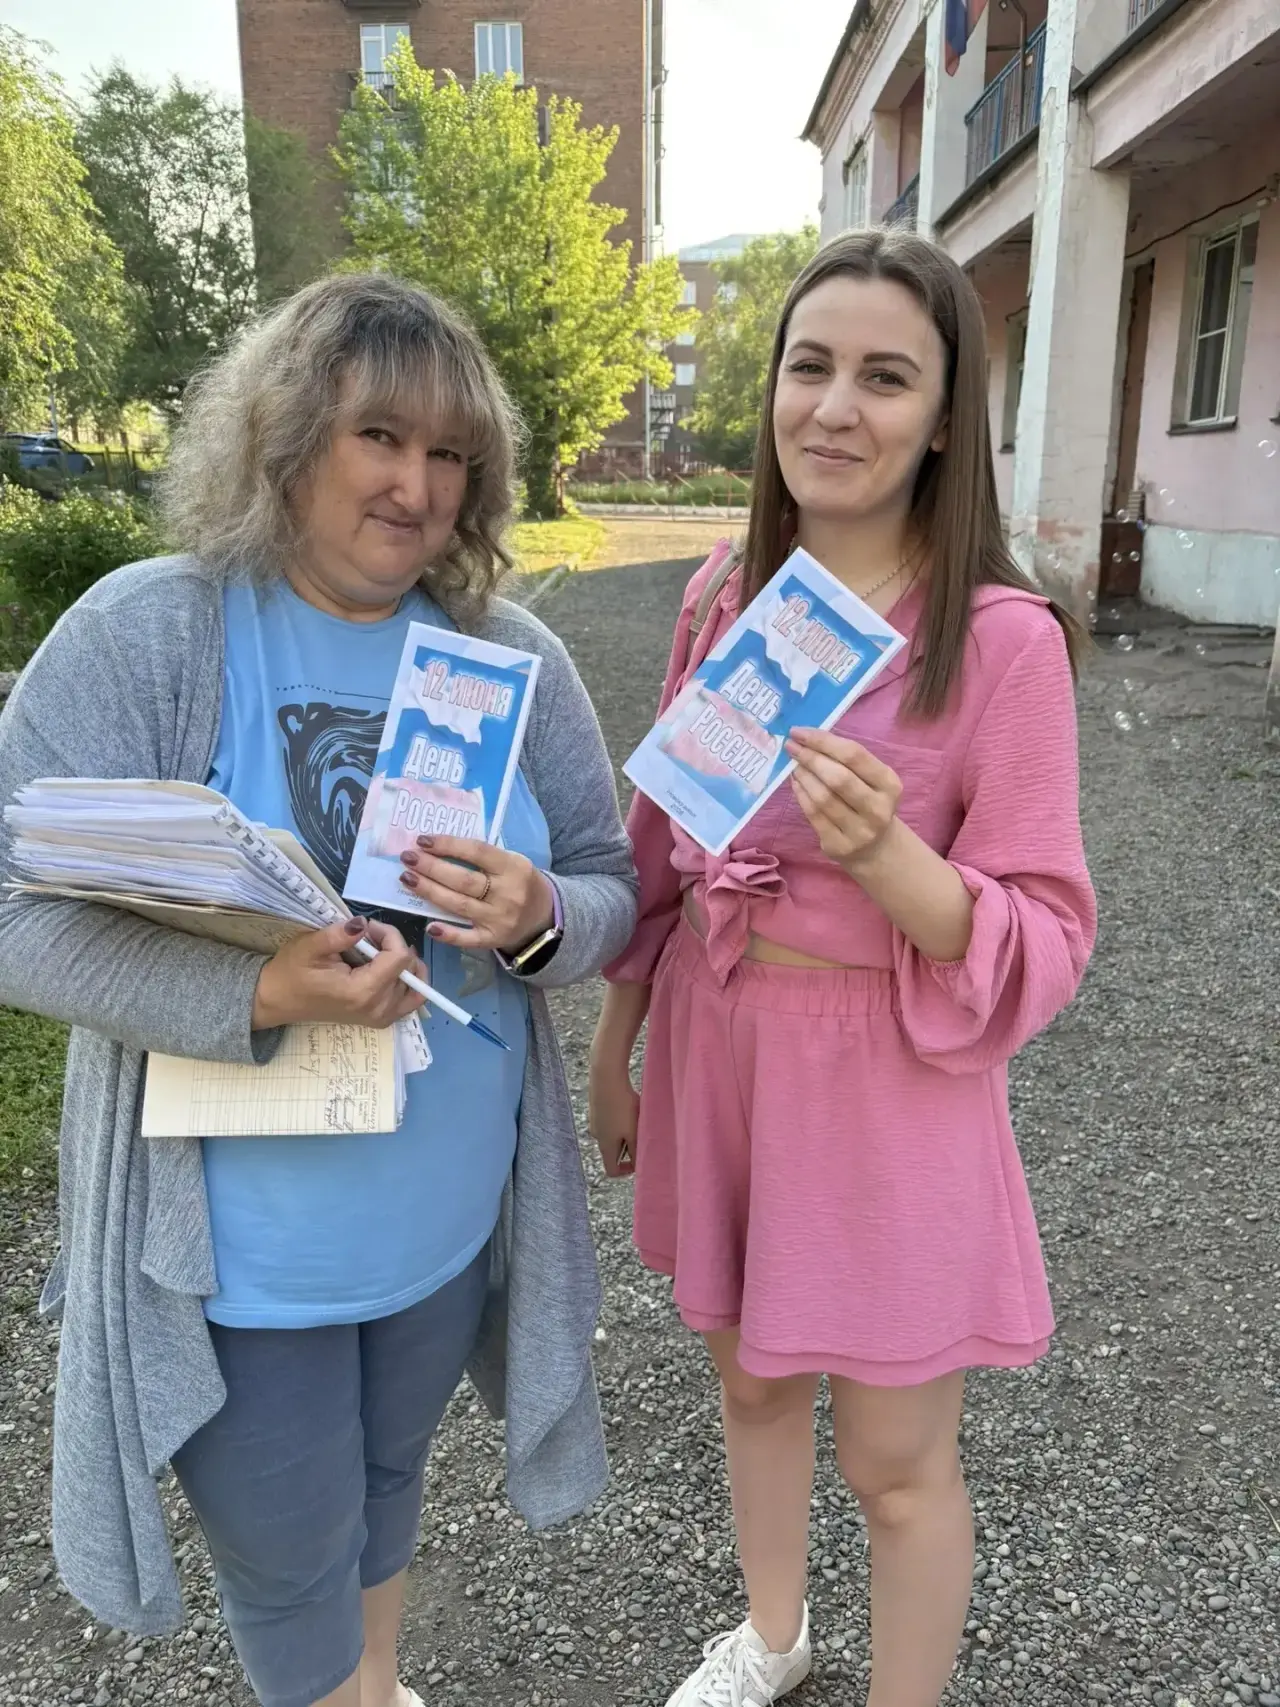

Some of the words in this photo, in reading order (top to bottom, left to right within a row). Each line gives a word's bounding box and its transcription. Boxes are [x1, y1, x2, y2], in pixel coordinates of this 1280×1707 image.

[771, 594, 809, 638] 12
[421, 659, 449, 701] 12
[717, 659, 783, 725] День
[403, 735, 465, 786] День
[687, 704, 769, 783] России
[391, 791, 479, 839] России
